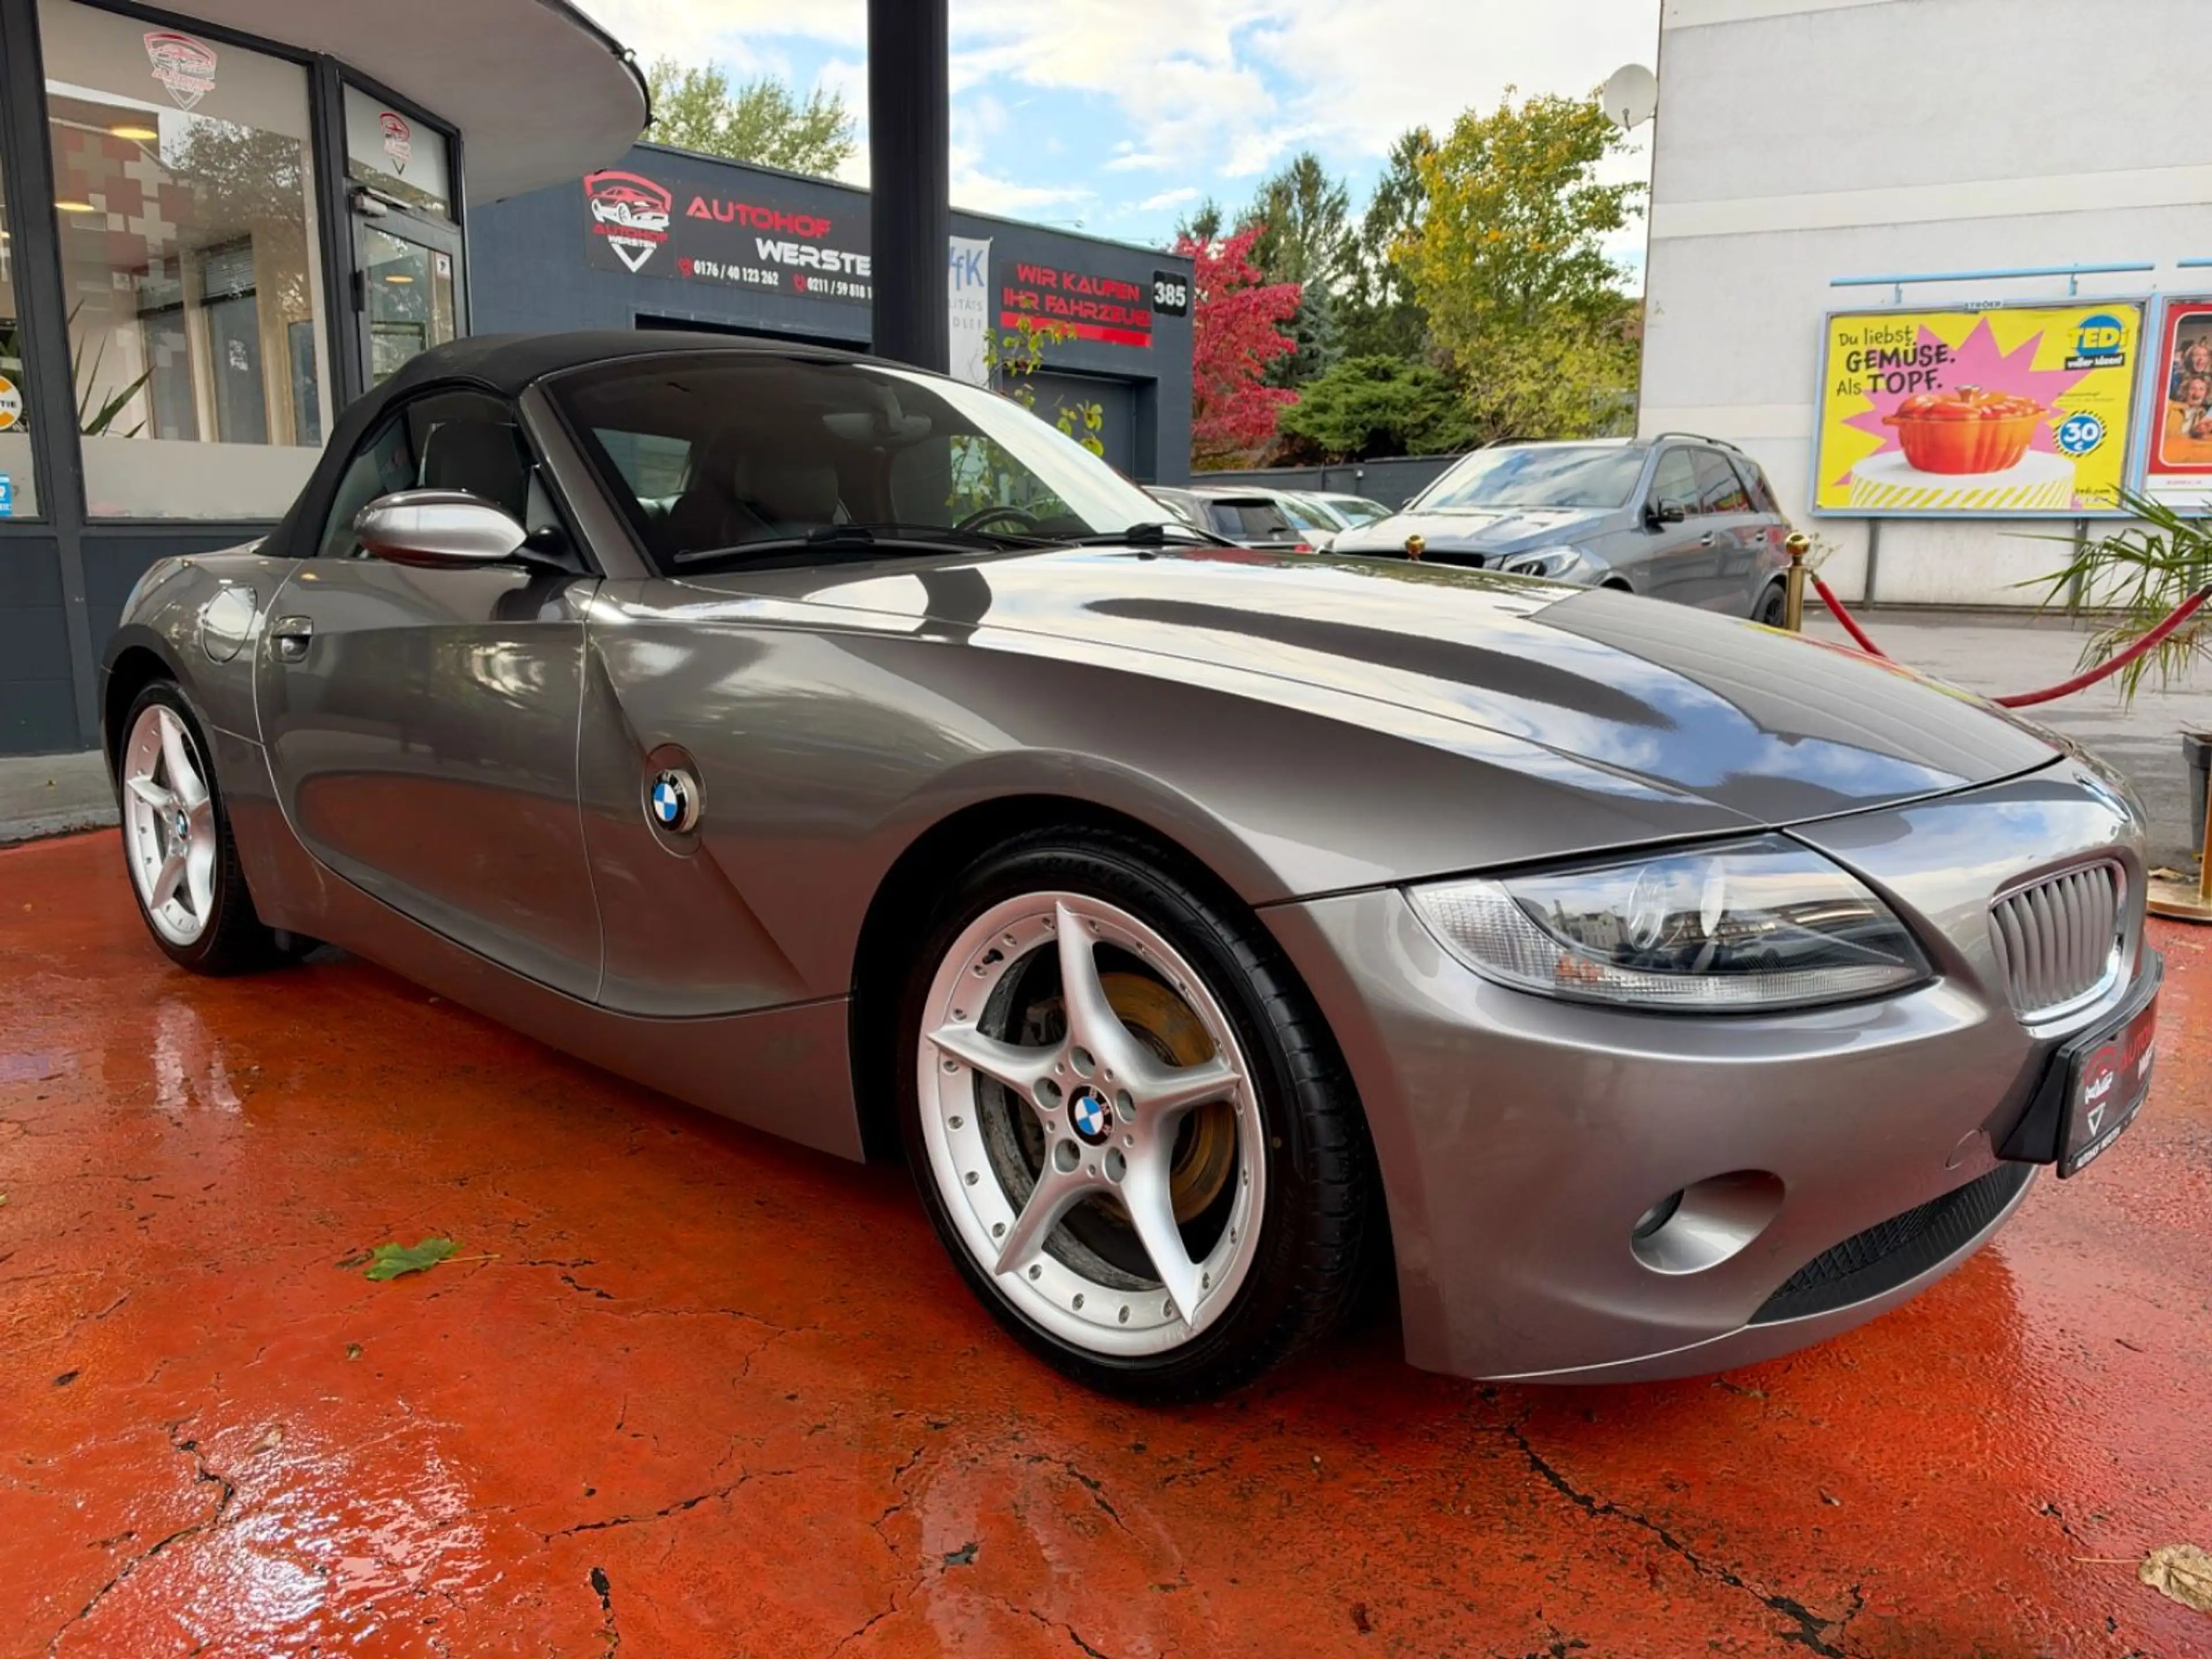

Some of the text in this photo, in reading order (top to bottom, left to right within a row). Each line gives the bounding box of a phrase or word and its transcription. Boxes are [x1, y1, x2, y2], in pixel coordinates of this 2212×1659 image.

[686, 195, 832, 238] AUTOHOF
[755, 237, 872, 276] WERSTE
[694, 259, 719, 278] 0176
[726, 265, 740, 281] 40
[742, 267, 760, 283] 123
[761, 270, 779, 286] 262
[1017, 263, 1140, 302] WIR KAUFEN
[1003, 287, 1040, 310] IHR
[1154, 282, 1185, 307] 385
[1839, 324, 1913, 346] Du liebst
[1846, 342, 1956, 373] GEMÜSE.
[1836, 368, 1943, 396] Als TOPF.
[2063, 422, 2099, 443] 30
